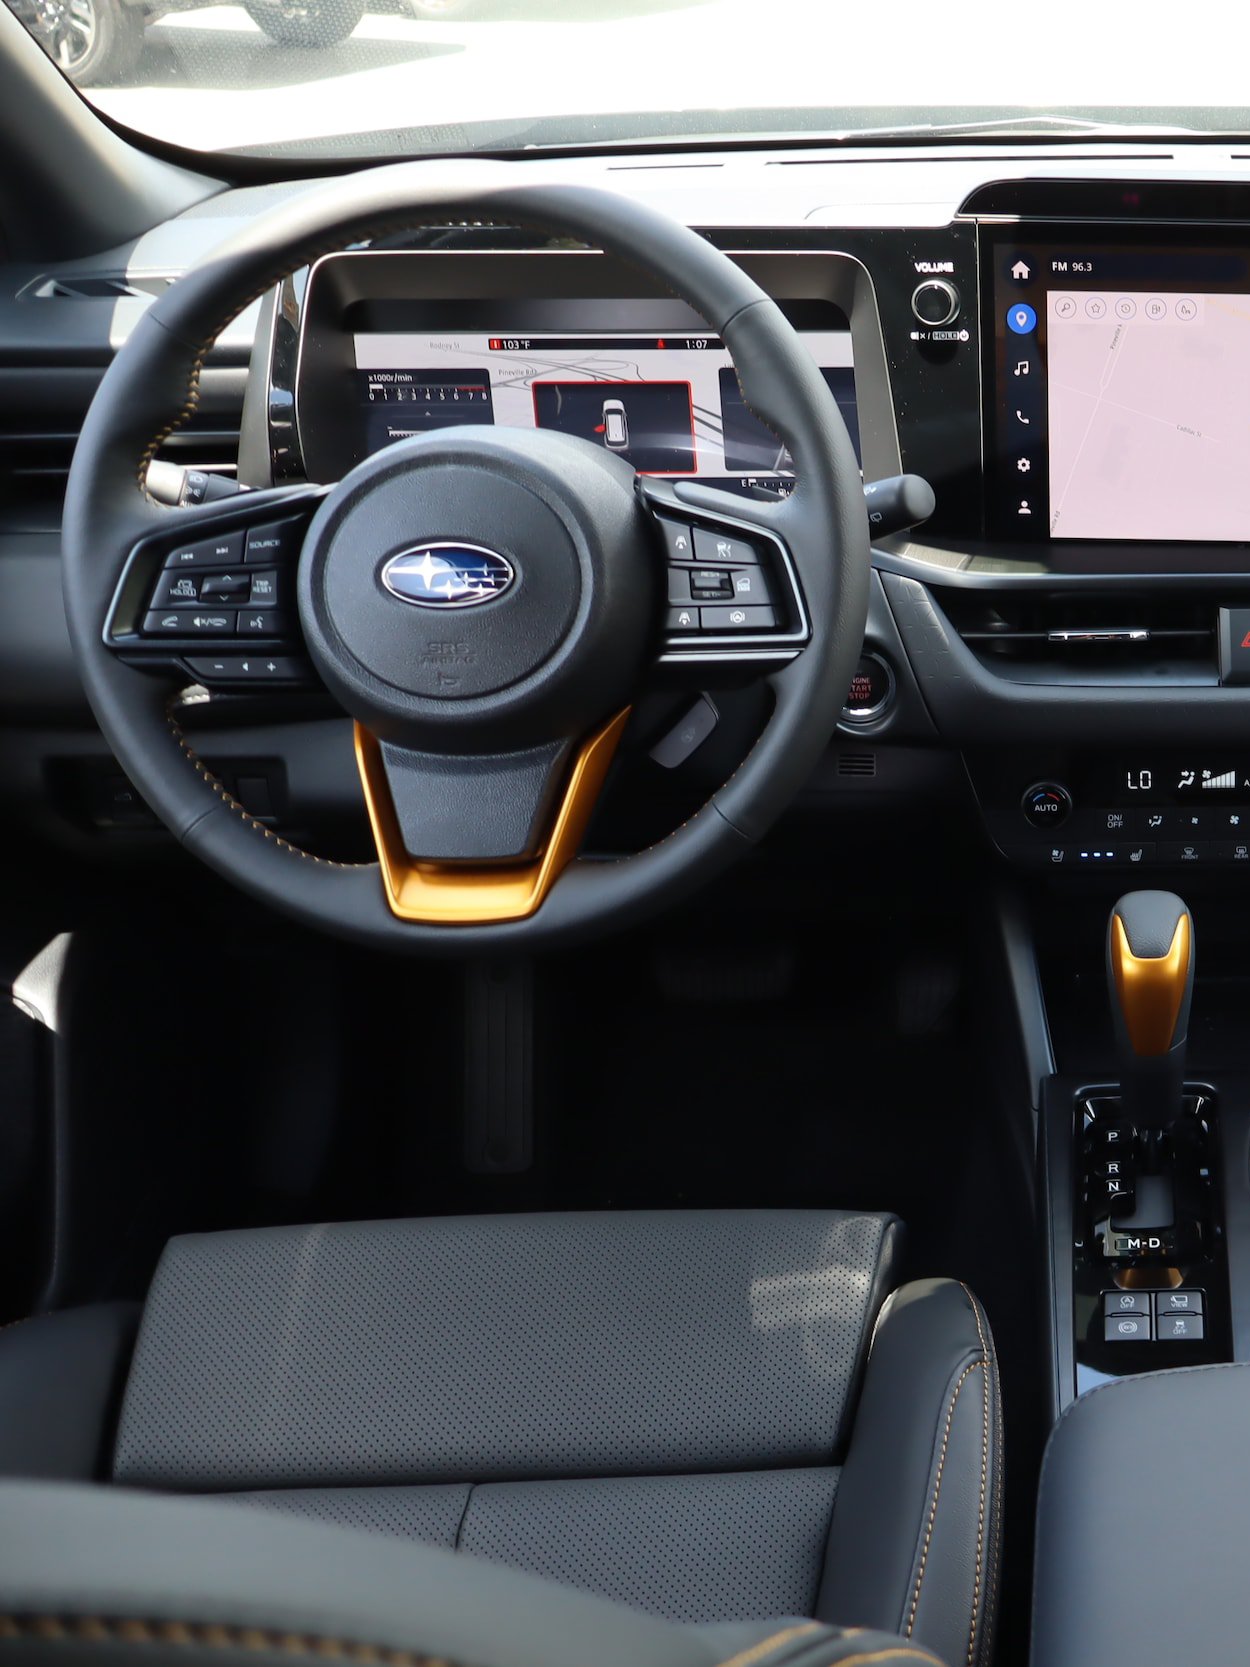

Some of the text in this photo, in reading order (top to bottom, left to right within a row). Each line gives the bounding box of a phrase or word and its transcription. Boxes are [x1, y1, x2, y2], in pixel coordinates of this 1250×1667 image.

[914, 262, 954, 272] VOLUME
[1052, 262, 1092, 271] FM 96.3
[503, 341, 519, 349] 103
[686, 340, 707, 349] 1:07
[368, 374, 413, 383] x1000r/min
[249, 540, 280, 549] SOURCE
[428, 642, 469, 653] SRS
[1128, 770, 1151, 789] LO
[1107, 1132, 1118, 1141] P
[1108, 1164, 1119, 1173] R
[1108, 1183, 1119, 1191] N
